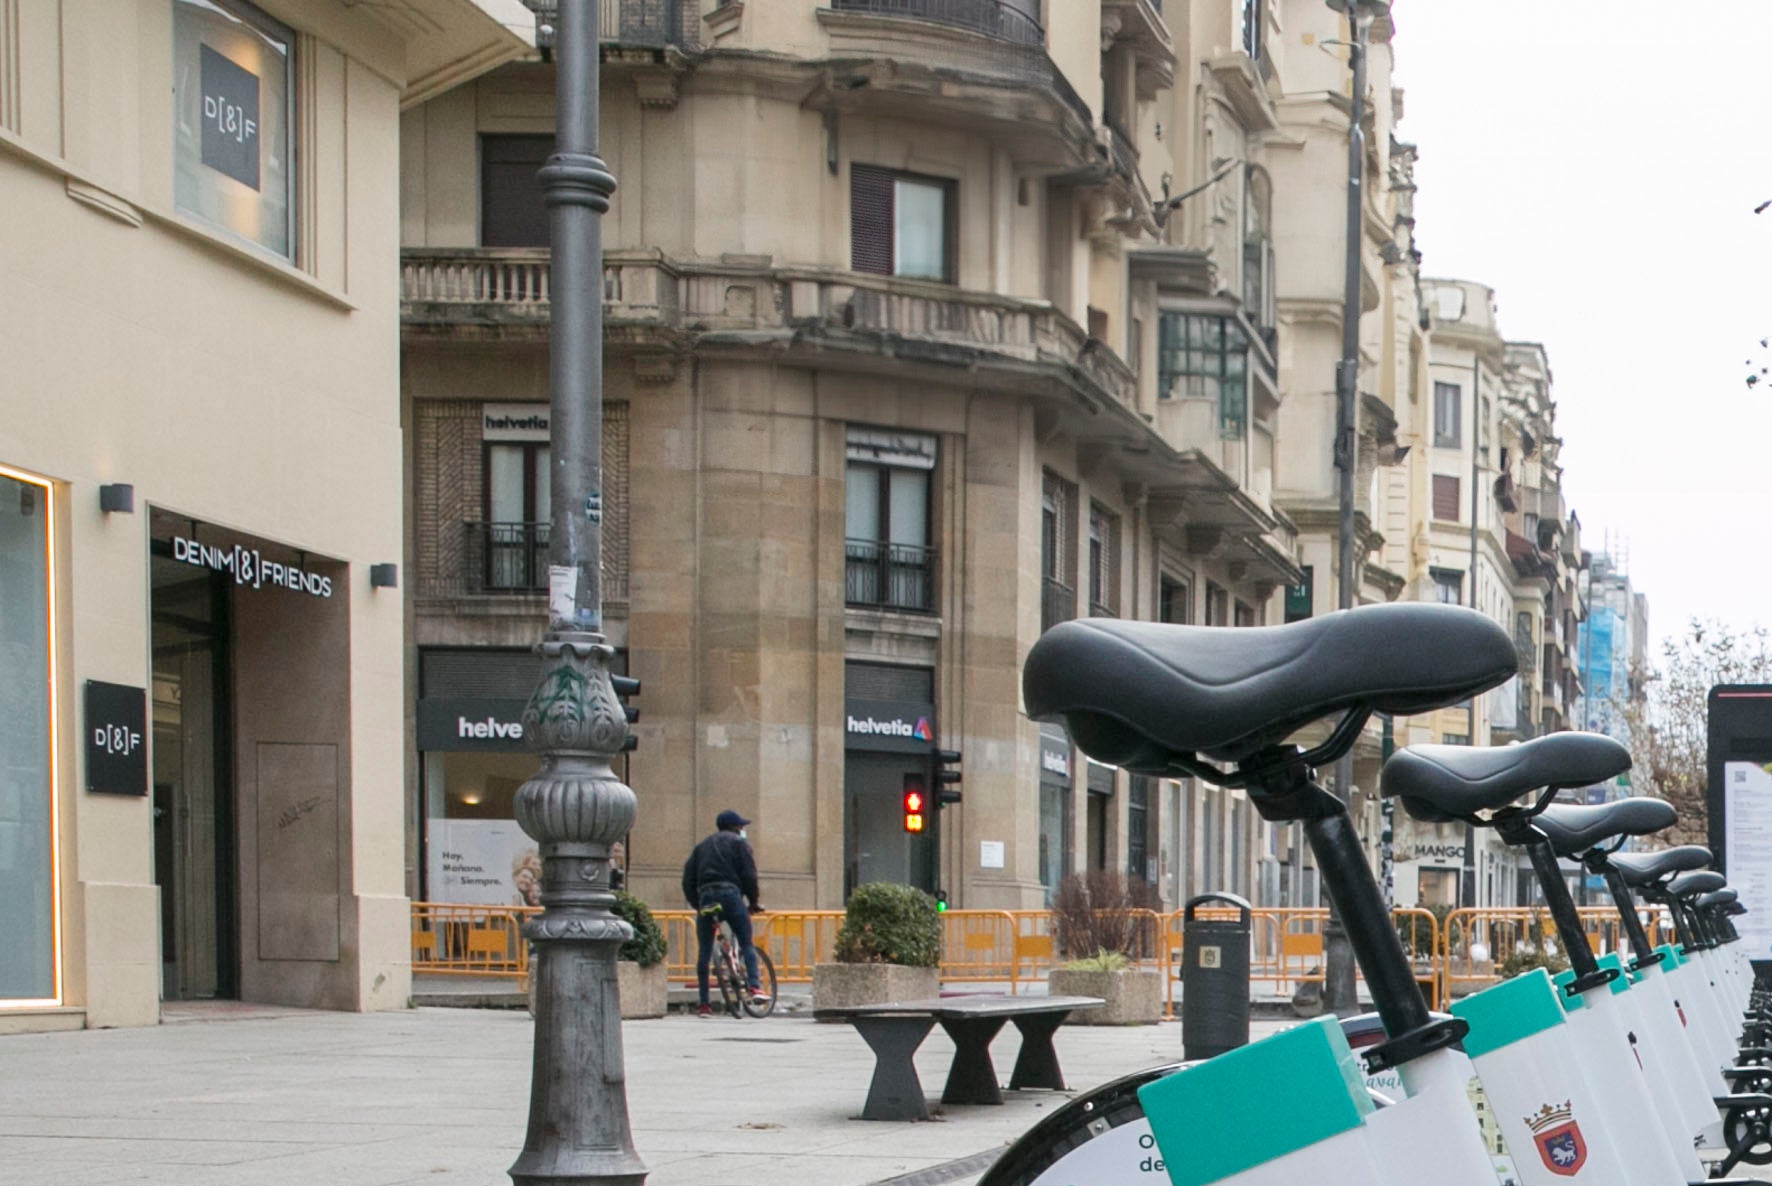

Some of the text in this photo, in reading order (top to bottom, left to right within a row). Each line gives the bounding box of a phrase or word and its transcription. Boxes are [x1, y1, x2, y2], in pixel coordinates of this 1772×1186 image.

[485, 415, 549, 430] helvetia
[458, 716, 524, 739] helve
[847, 715, 913, 737] helvetia
[1414, 844, 1465, 858] MANGO
